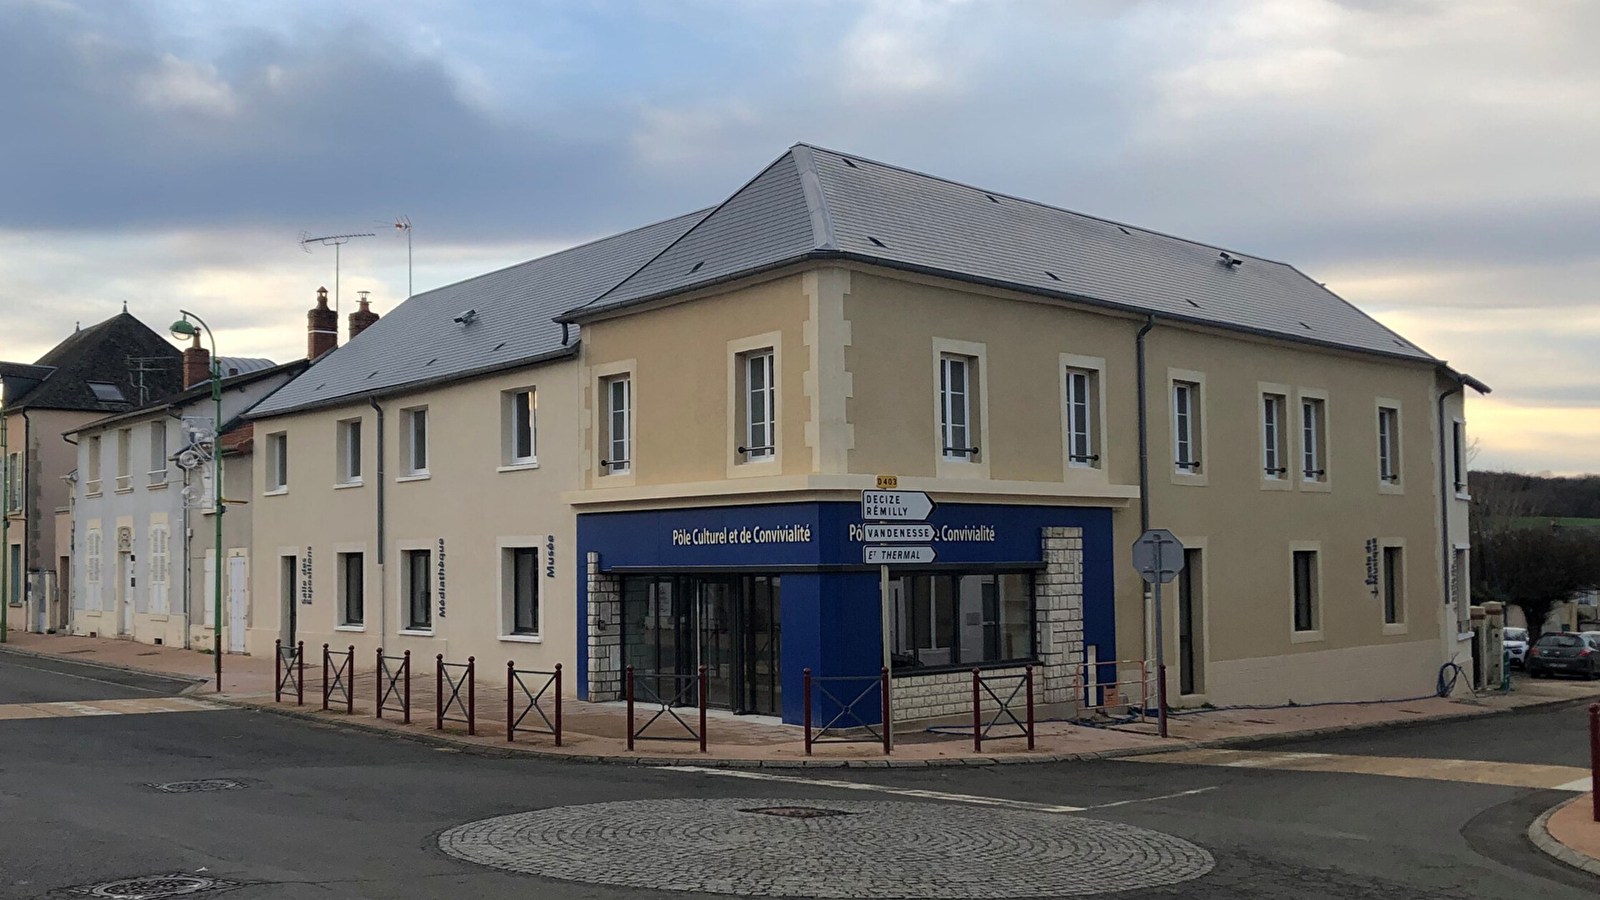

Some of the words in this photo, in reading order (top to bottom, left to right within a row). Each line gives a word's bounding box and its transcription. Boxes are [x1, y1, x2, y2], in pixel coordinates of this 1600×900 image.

[877, 477, 882, 486] D
[883, 477, 898, 486] 403
[866, 494, 900, 505] DECIZE
[866, 505, 908, 516] RÉMILLY
[672, 529, 691, 546] Pôle
[692, 526, 727, 545] Culturel
[728, 528, 739, 544] et
[740, 526, 752, 544] de
[753, 524, 811, 543] Convivialité
[849, 524, 864, 542] Pô
[941, 524, 996, 542] Convivialité
[867, 528, 930, 538] VANDENESSE
[546, 535, 555, 578] Musée
[881, 550, 921, 560] THERMAL
[438, 538, 446, 618] Médiathèque
